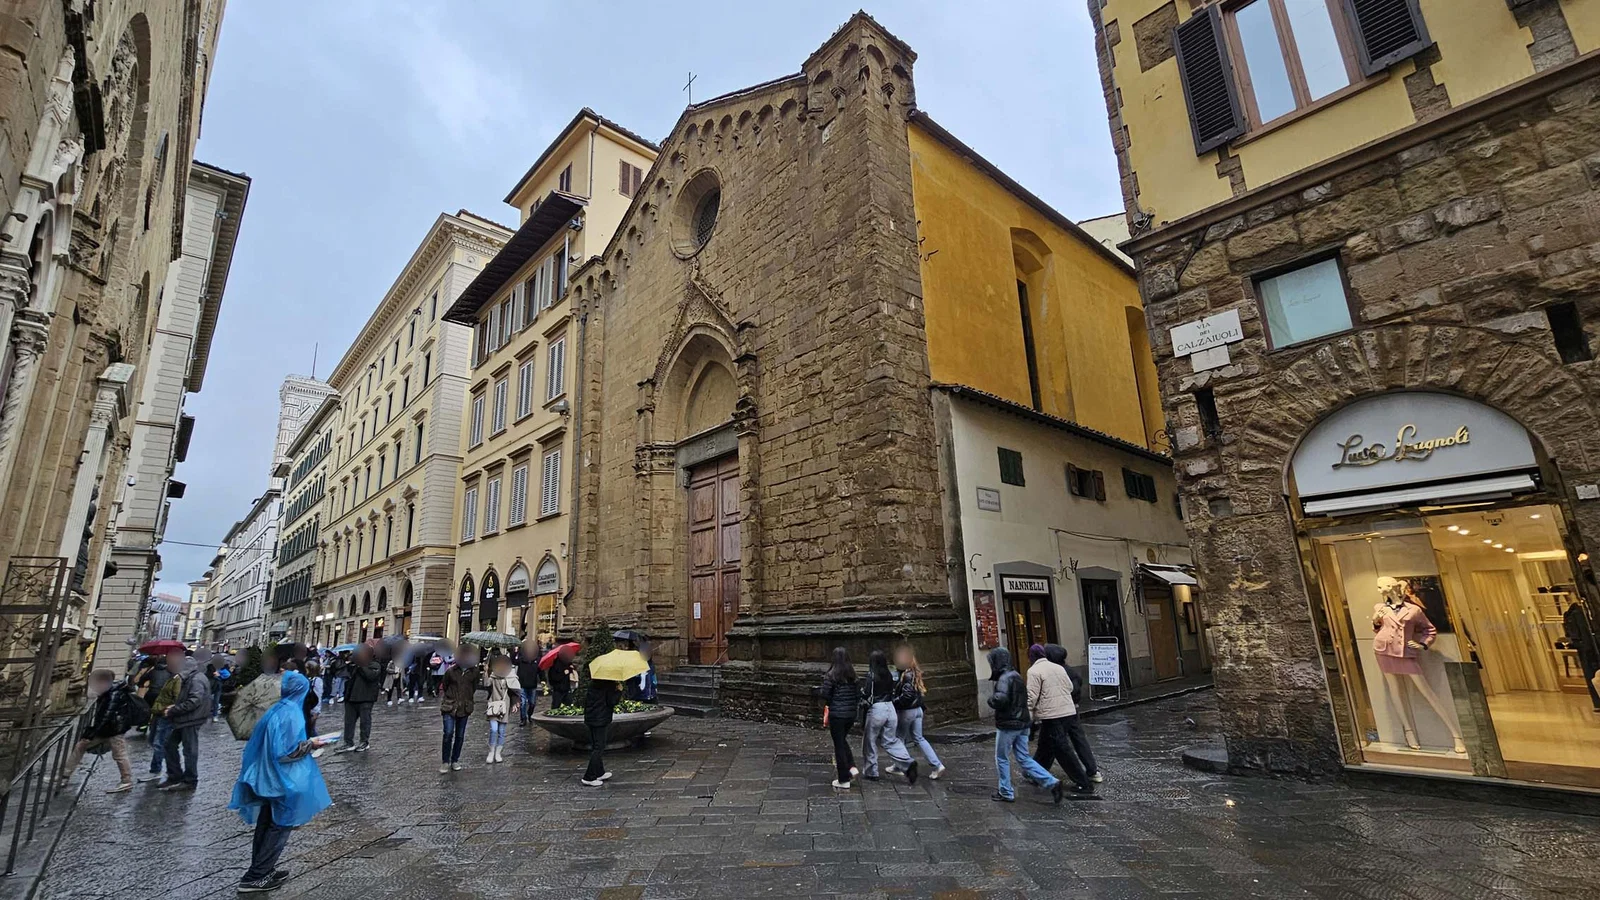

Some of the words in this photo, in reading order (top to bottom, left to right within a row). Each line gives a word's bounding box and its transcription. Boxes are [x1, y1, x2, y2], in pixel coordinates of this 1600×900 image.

[1196, 322, 1211, 330] VIA
[1177, 328, 1239, 352] CALZAIUOLI
[1390, 424, 1470, 462] Spagnoli
[1008, 580, 1045, 591] NANNELLI
